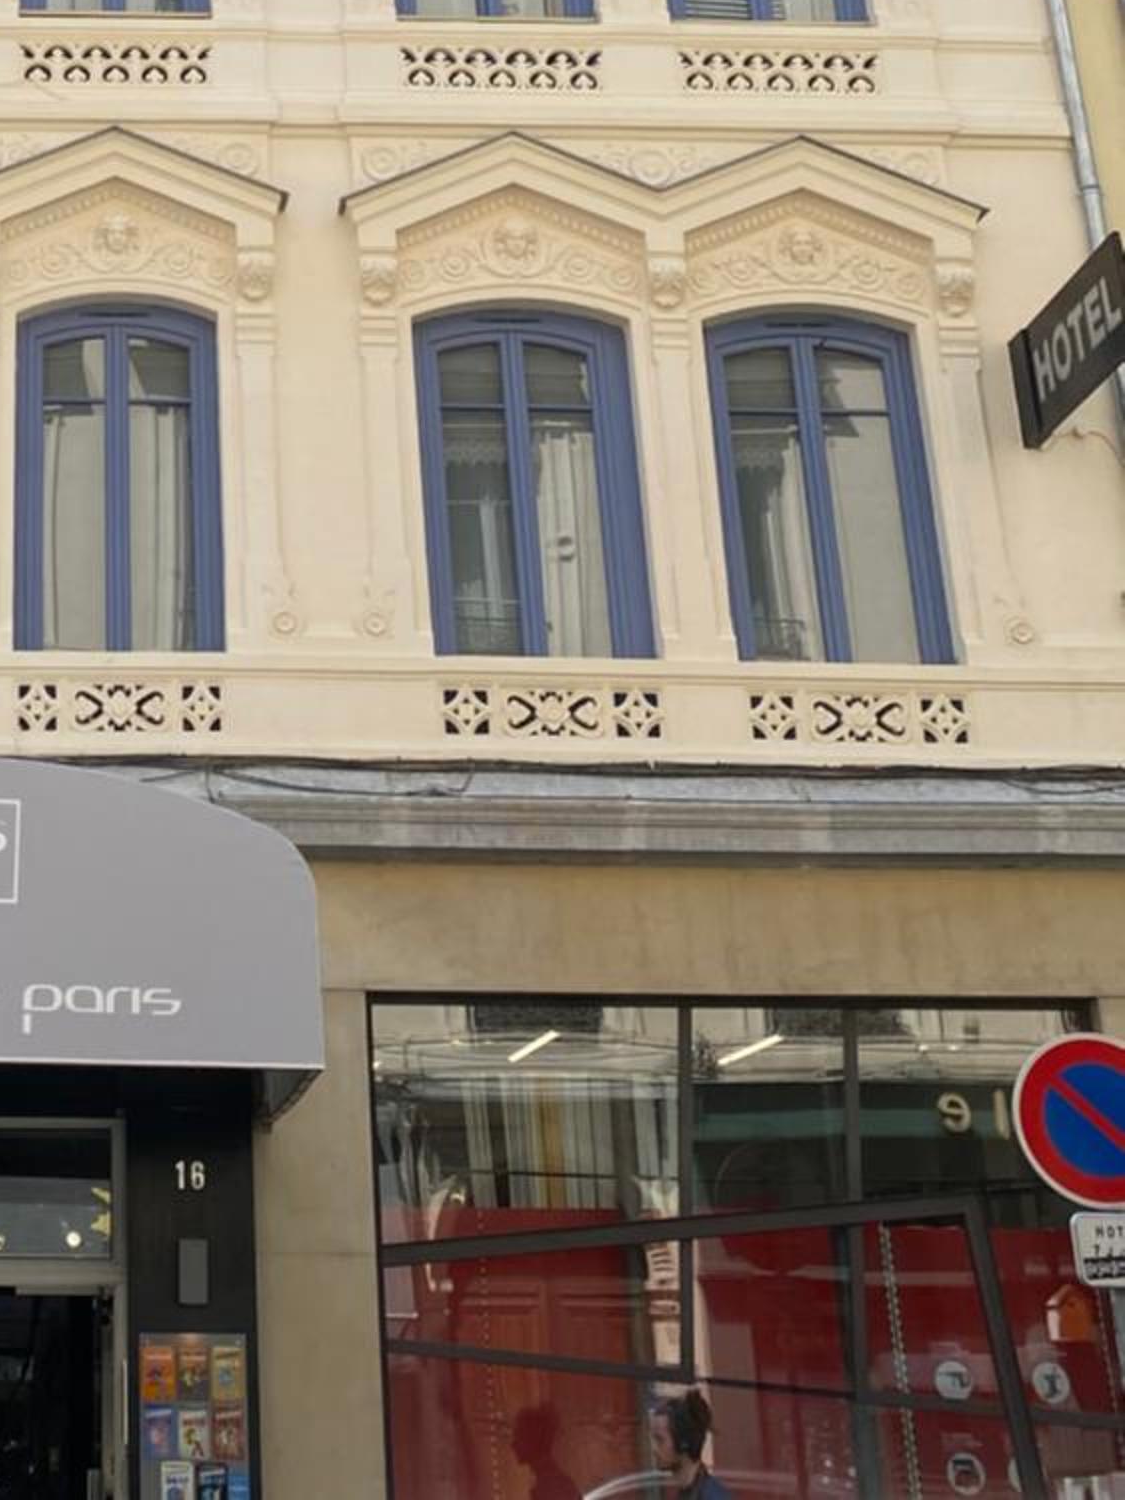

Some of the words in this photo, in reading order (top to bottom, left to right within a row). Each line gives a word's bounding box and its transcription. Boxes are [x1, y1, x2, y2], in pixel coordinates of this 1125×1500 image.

[1032, 275, 1123, 402] HOTEL
[22, 983, 182, 1035] paris
[175, 1160, 206, 1190] 16
